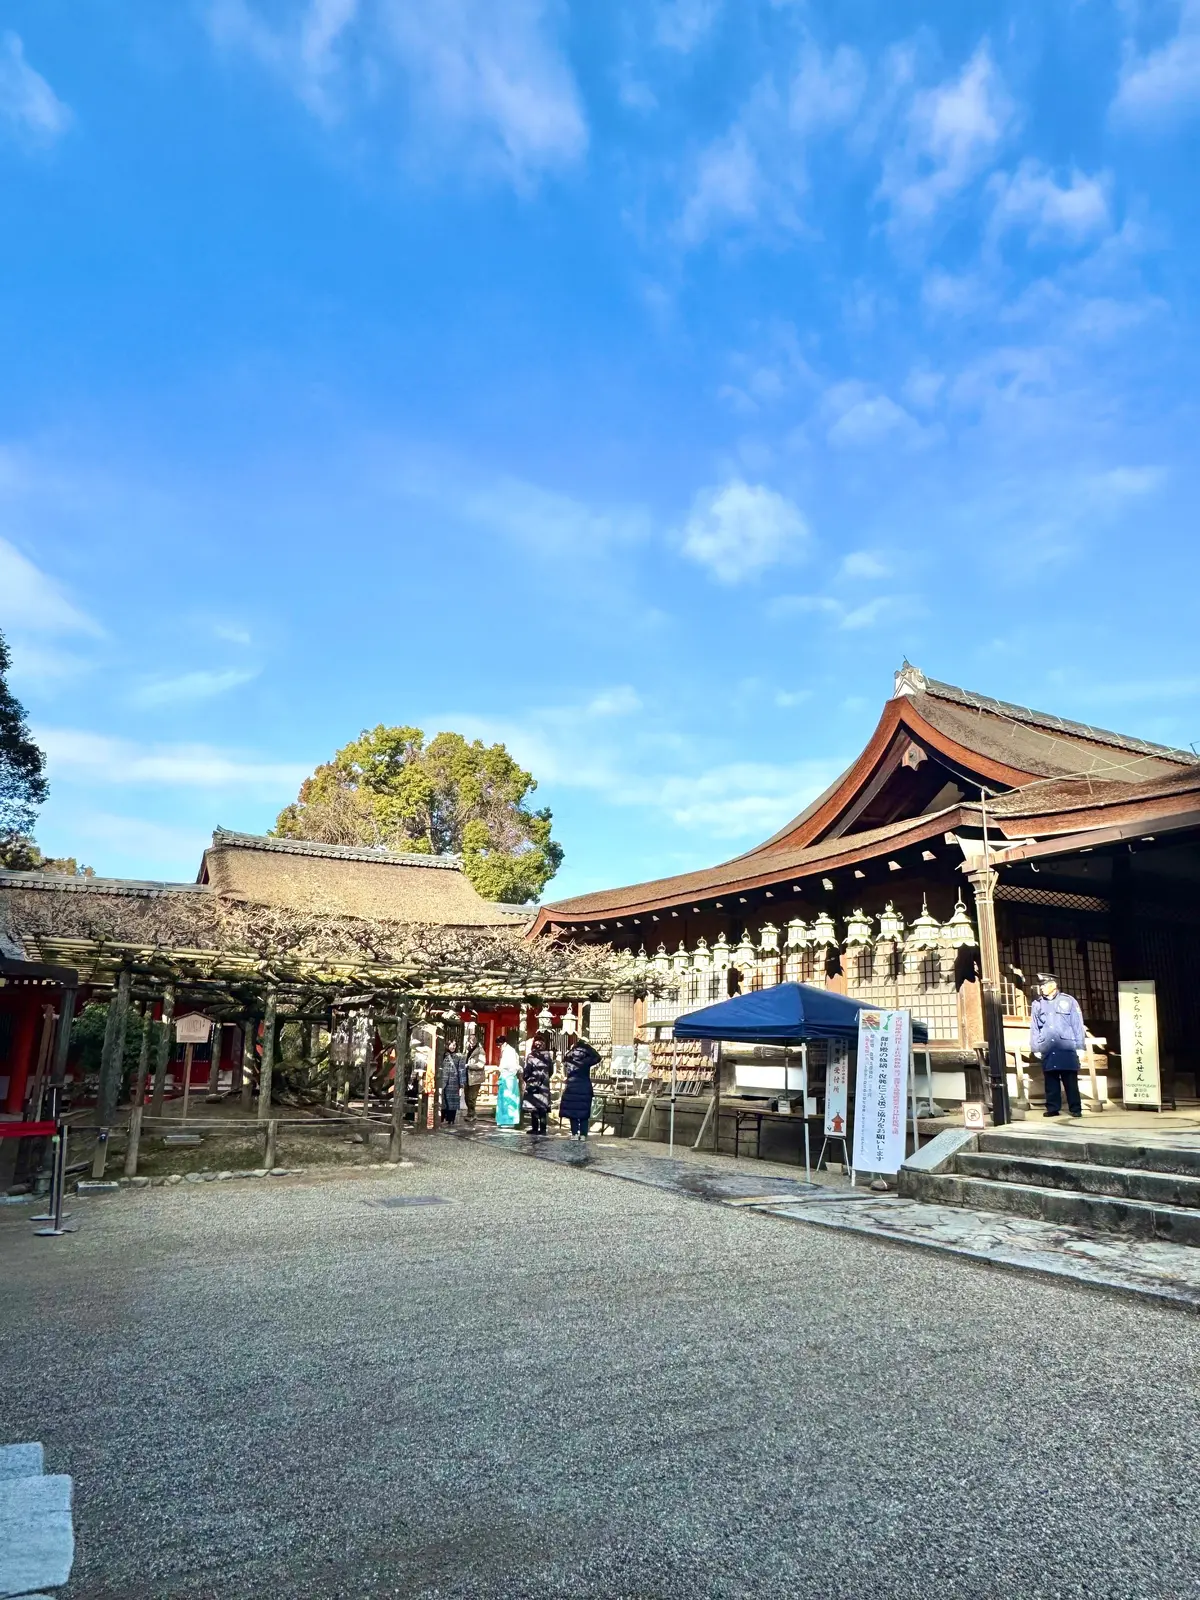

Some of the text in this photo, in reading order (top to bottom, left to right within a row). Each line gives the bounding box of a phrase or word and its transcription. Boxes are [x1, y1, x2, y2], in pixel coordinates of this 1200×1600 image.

[1133, 987, 1144, 1082] こちらからは入れません
